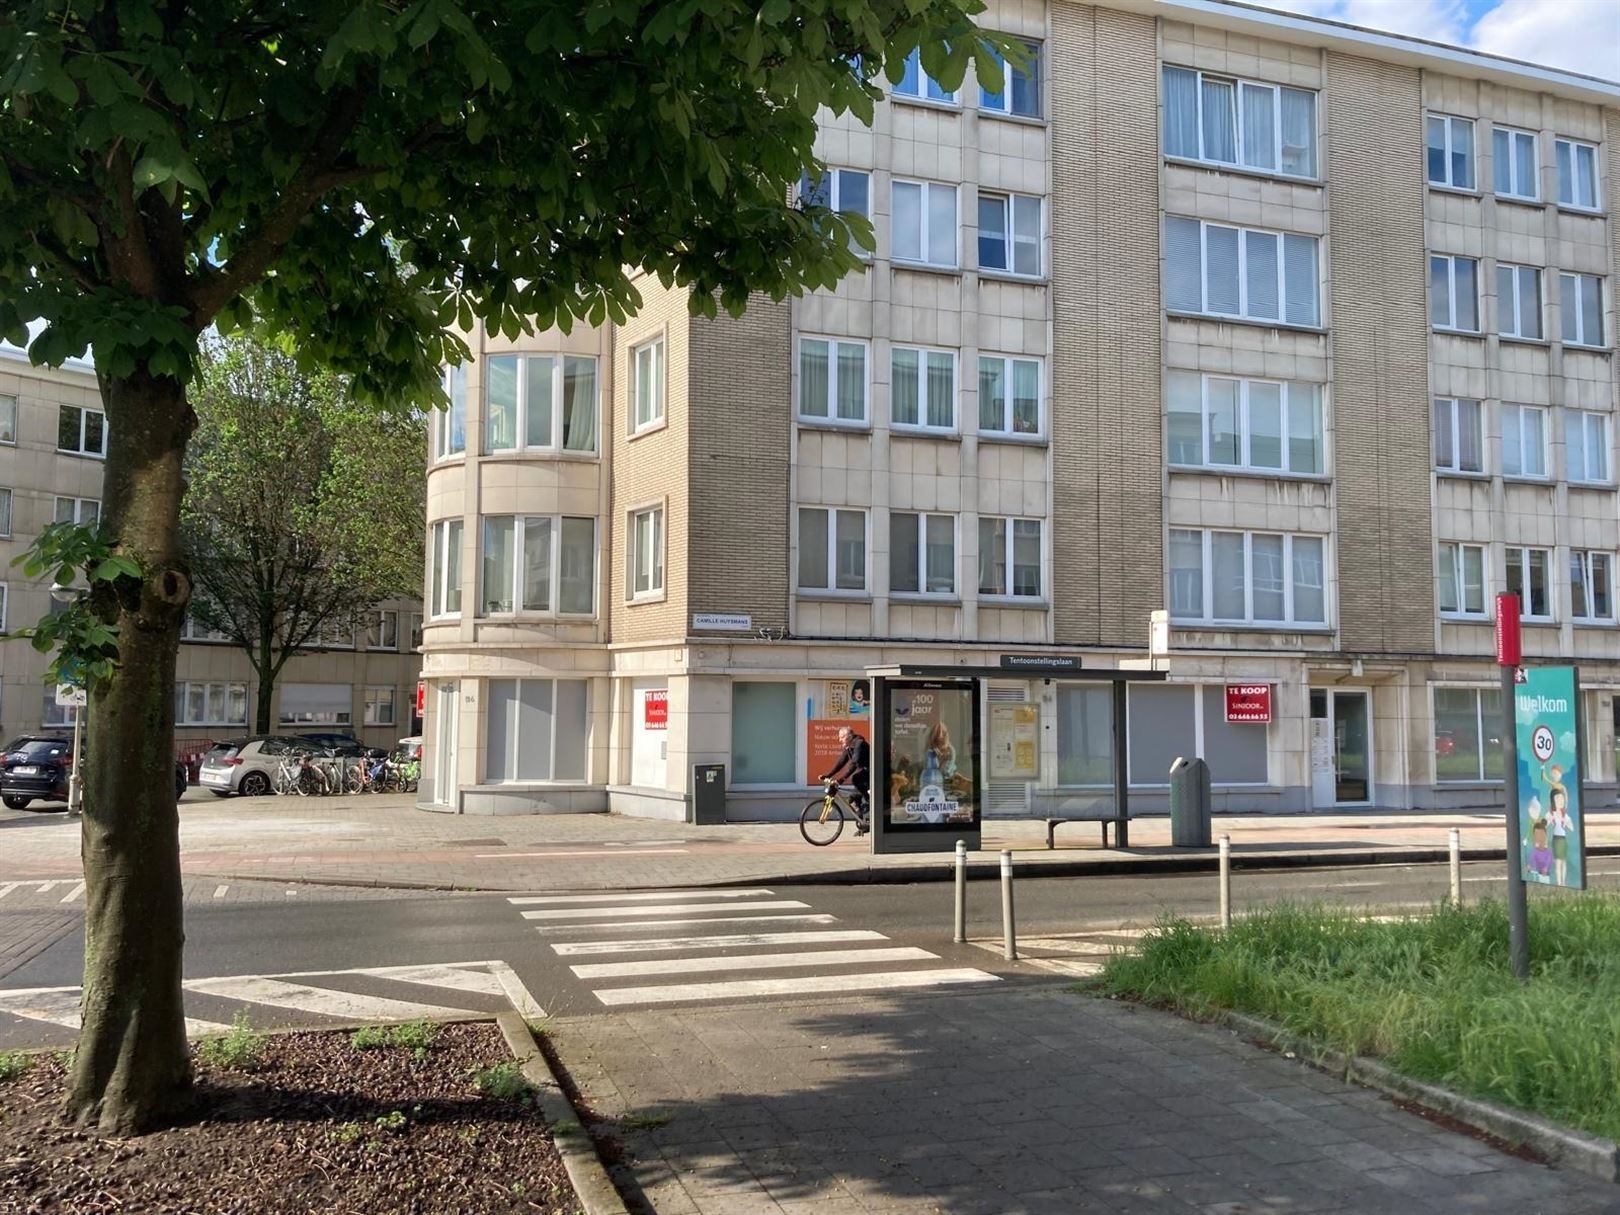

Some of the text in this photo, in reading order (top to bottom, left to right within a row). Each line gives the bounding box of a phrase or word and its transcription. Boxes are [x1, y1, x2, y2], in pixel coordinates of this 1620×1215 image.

[1009, 657, 1073, 666] Tentoonstellingslaan
[1228, 687, 1267, 695] TE KOOP
[645, 692, 652, 701] TE
[916, 695, 933, 704] 100
[911, 700, 932, 716] jaar
[1520, 696, 1567, 713] Welkom
[1537, 736, 1552, 751] 30
[907, 803, 957, 812] CHAUDFONTAINE
